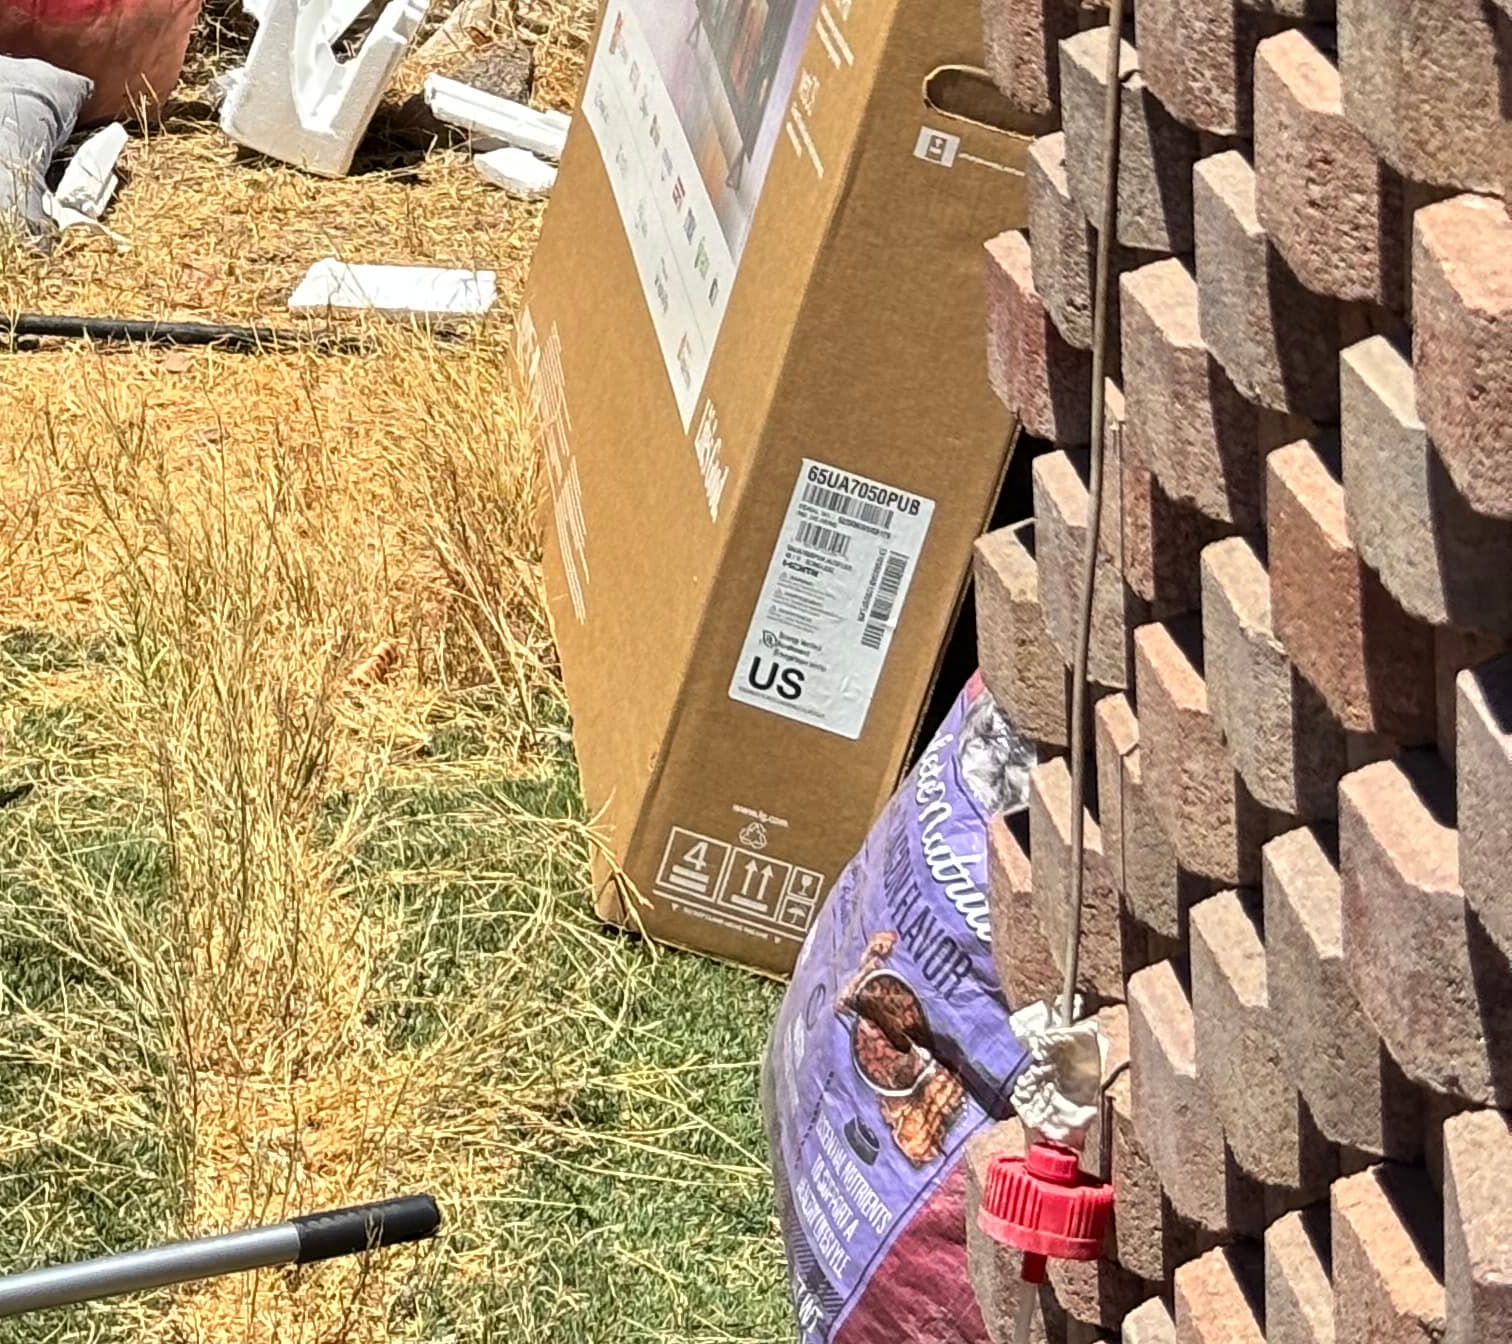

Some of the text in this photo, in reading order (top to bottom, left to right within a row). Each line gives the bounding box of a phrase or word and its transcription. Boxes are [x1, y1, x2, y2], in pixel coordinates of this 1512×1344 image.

[807, 464, 921, 517] 65UA7050PUB
[748, 655, 805, 700] US
[683, 841, 709, 871] 4
[890, 879, 973, 1001] FLAVOR
[810, 1152, 825, 1183] TO
[842, 1218, 860, 1243] A
[840, 1159, 893, 1235] NUTRIENTS
[812, 1210, 852, 1280] LIFESTYLE
